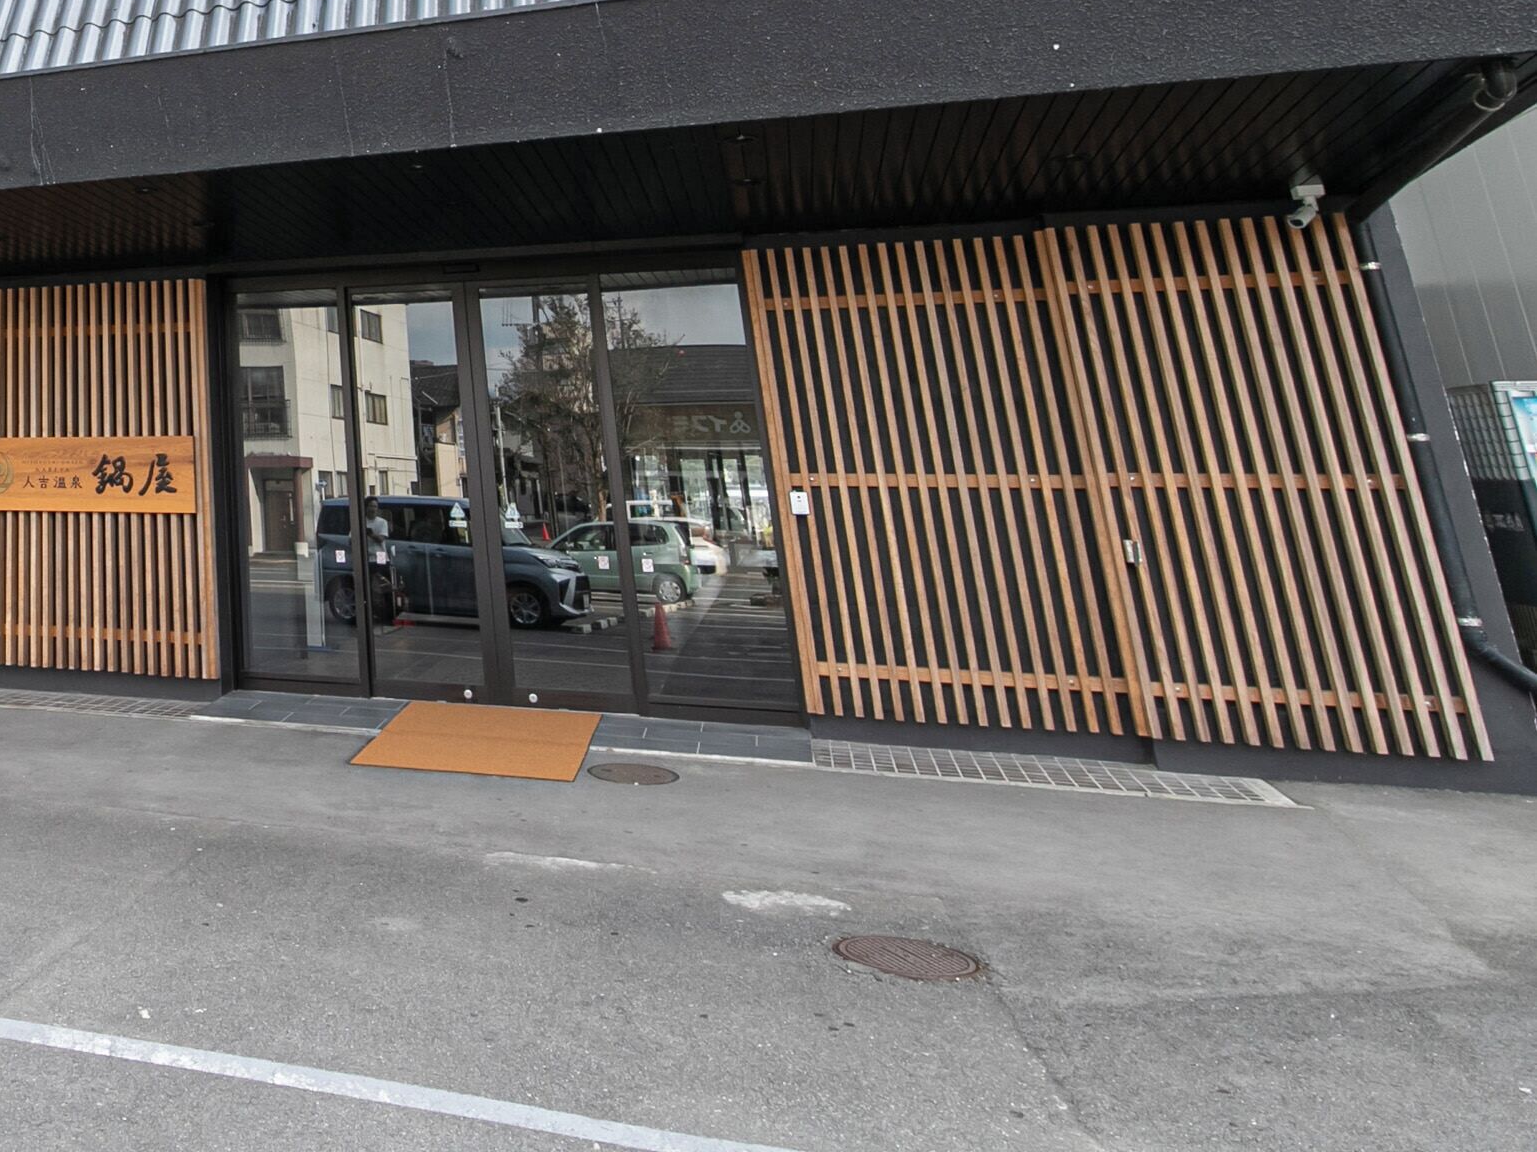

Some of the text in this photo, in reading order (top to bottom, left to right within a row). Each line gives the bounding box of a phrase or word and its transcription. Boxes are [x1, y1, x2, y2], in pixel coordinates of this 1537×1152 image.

[23, 475, 82, 488] 人吉温泉
[92, 453, 177, 496] 鍋屋
